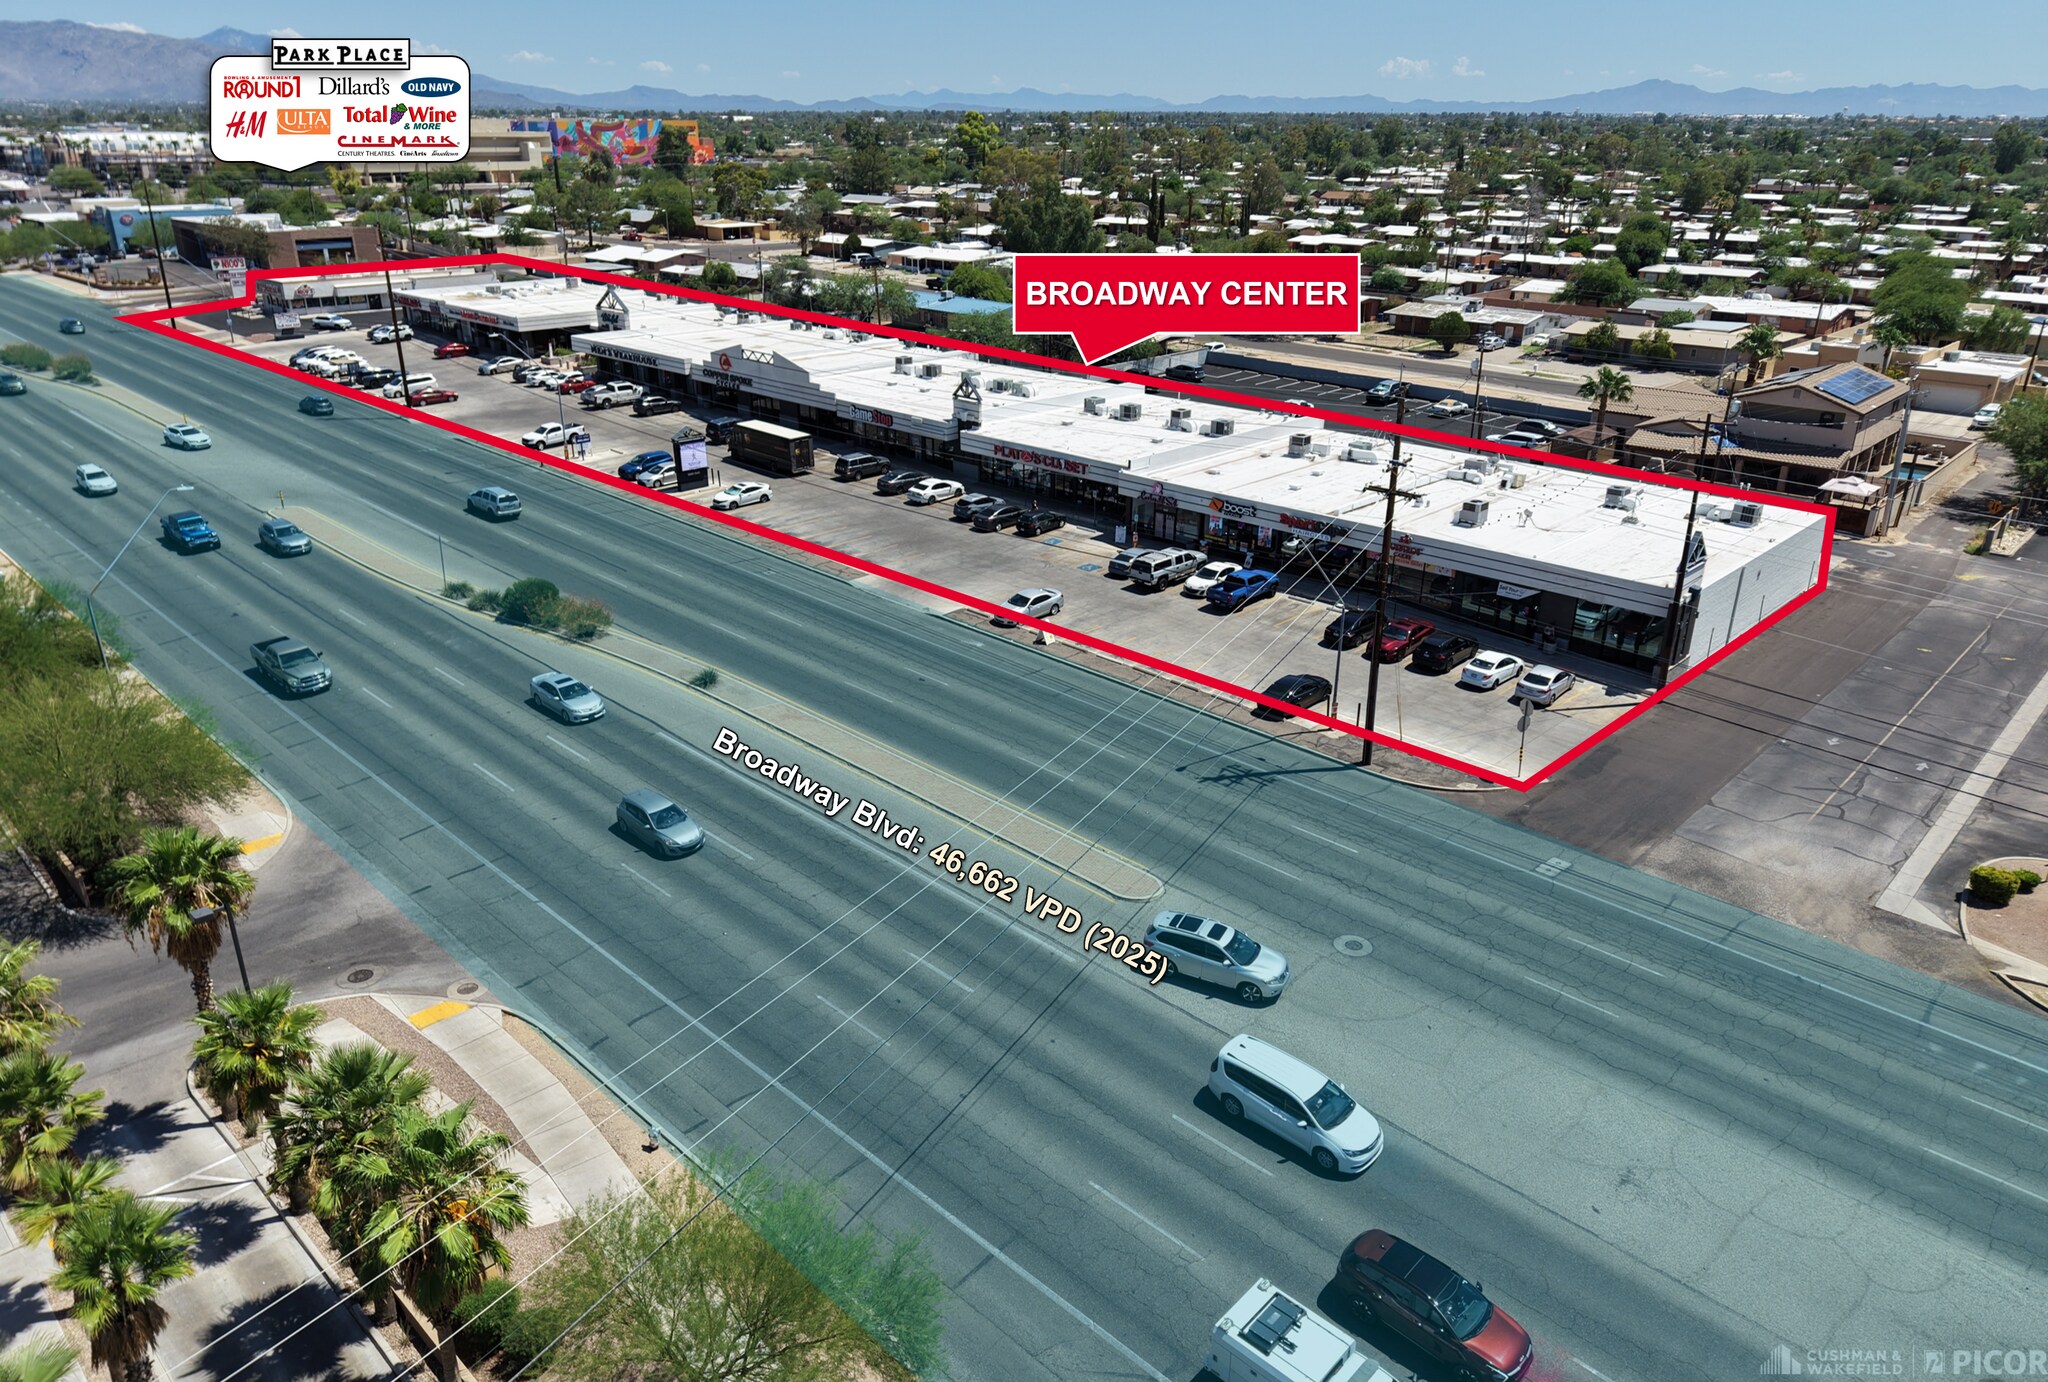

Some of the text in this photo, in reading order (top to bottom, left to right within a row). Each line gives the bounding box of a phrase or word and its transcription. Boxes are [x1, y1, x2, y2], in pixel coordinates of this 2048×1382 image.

[221, 257, 245, 268] NICO'S
[849, 404, 893, 428] GameStop
[993, 444, 1042, 466] PLATO'S
[1223, 501, 1257, 517] boost
